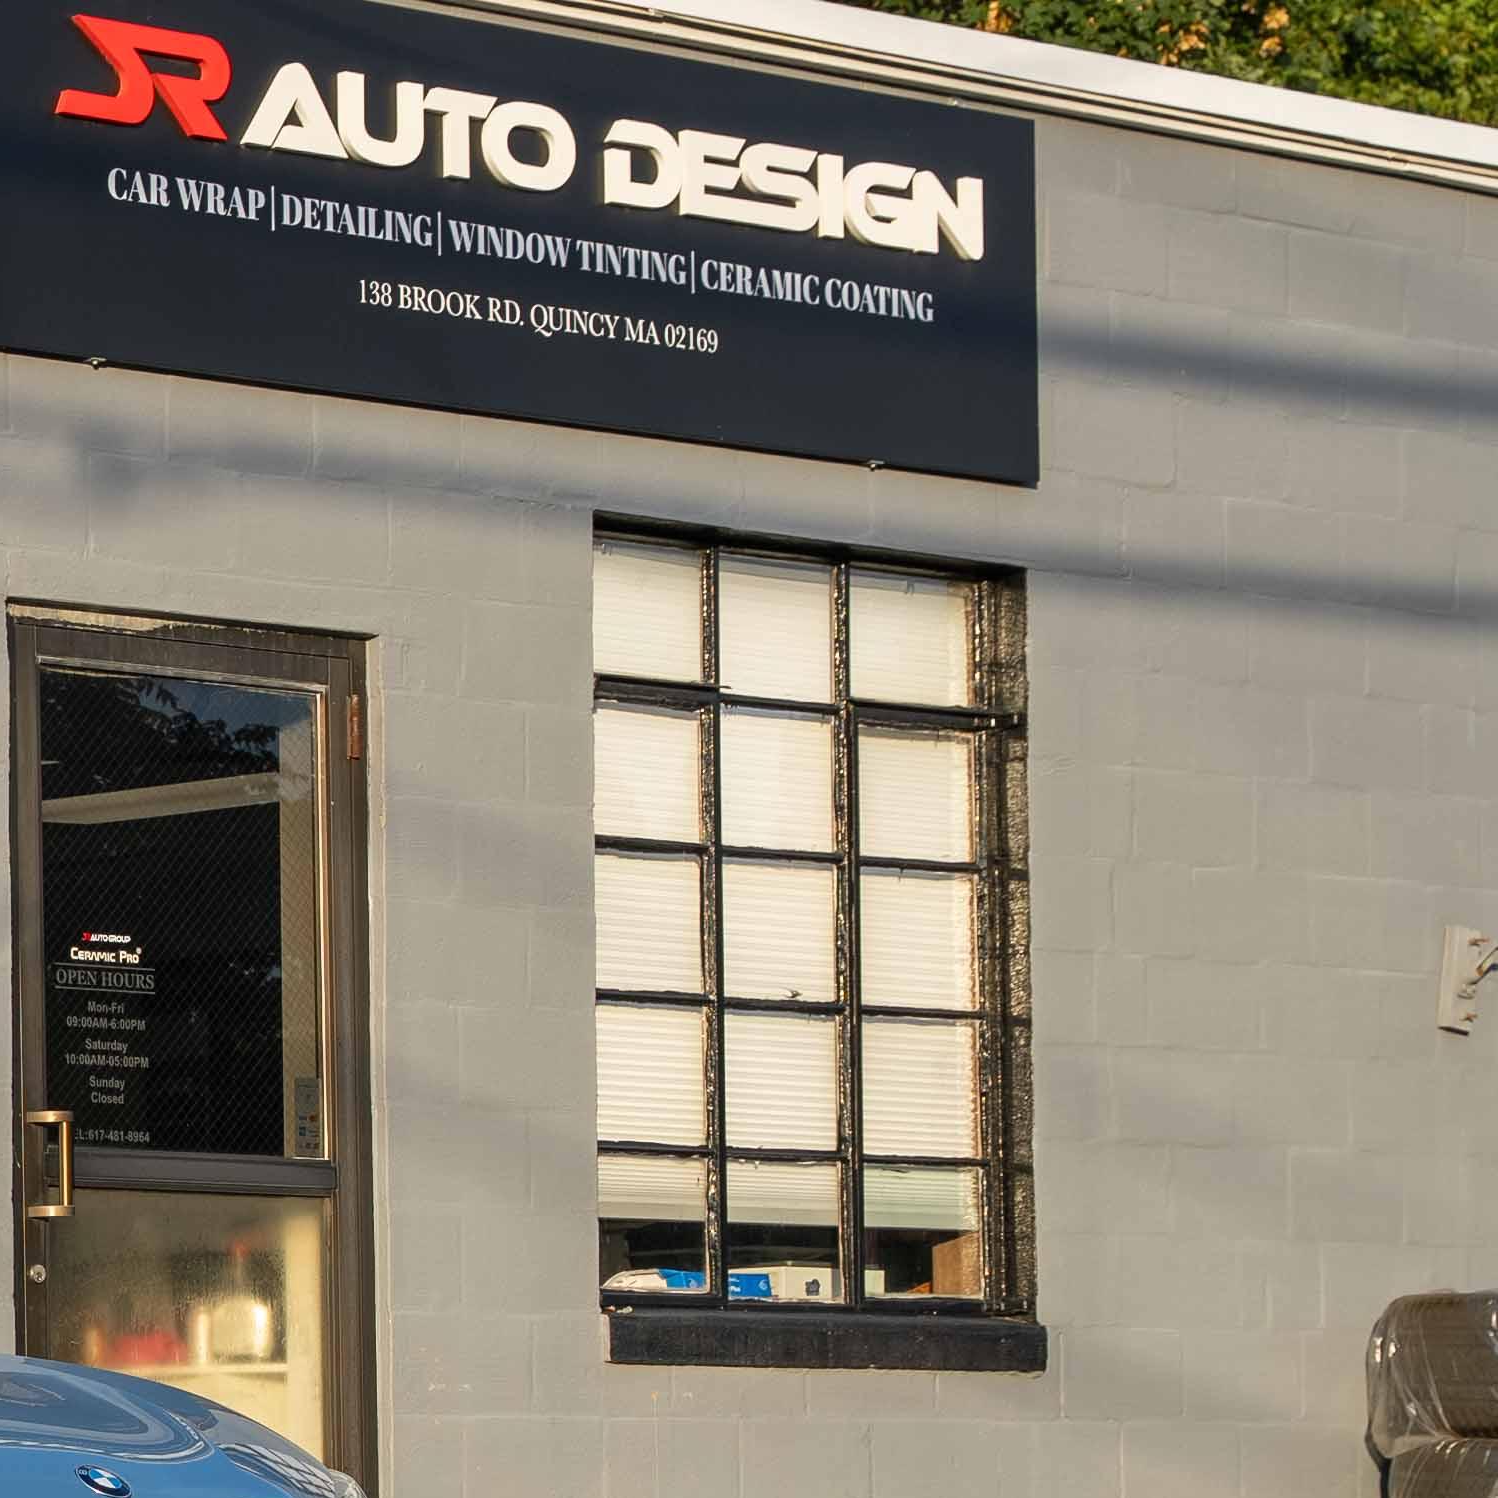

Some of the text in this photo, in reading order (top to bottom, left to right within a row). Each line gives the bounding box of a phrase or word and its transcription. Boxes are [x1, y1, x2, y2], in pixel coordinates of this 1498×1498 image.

[239, 62, 577, 192] AUTO
[603, 118, 984, 262] DESIGN
[107, 167, 935, 322] CAR WRAP DETAILING WINDOW TINTING CERAMIC COATING
[359, 279, 719, 354] 138 BROOK RD. QUINCY MA 02169
[70, 946, 116, 963] CERAMIC
[55, 968, 155, 989] OPEN HOURS
[85, 1038, 128, 1054] Saturday
[89, 1075, 125, 1091] Sunday
[90, 1092, 124, 1105] Closed
